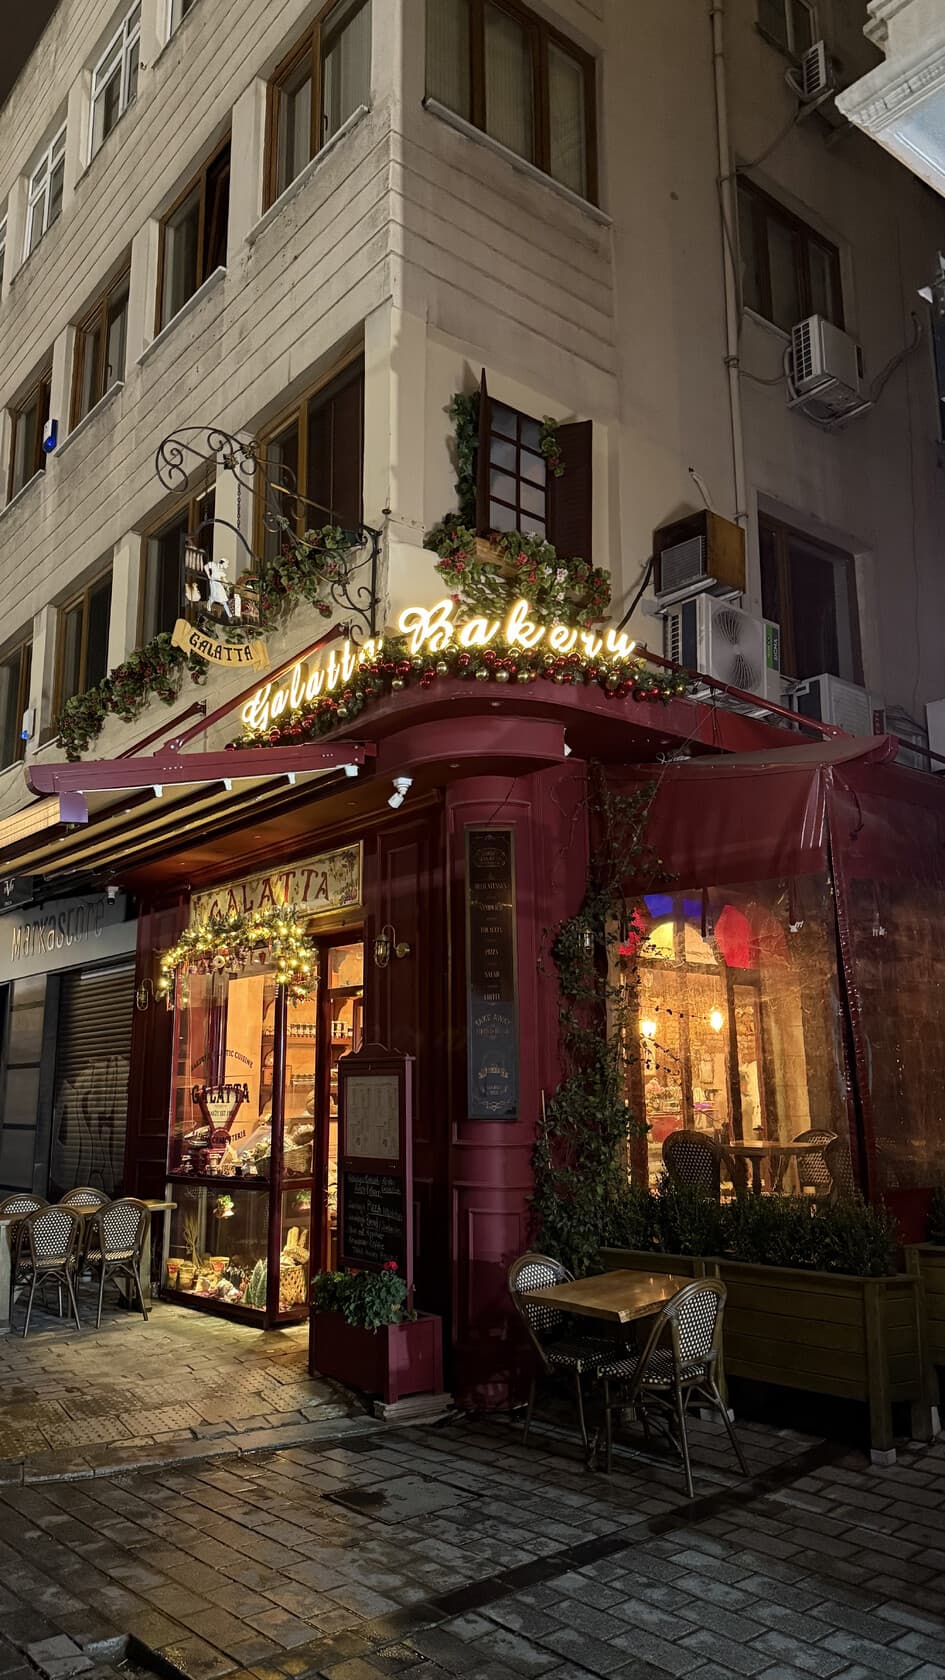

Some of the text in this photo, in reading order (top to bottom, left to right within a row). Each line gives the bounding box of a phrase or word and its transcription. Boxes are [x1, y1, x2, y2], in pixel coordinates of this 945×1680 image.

[398, 599, 635, 658] Bakery
[188, 631, 253, 662] GALATTA
[209, 868, 330, 918] GALATTA
[234, 1051, 254, 1069] CUISINE
[192, 1083, 250, 1104] GALATTA
